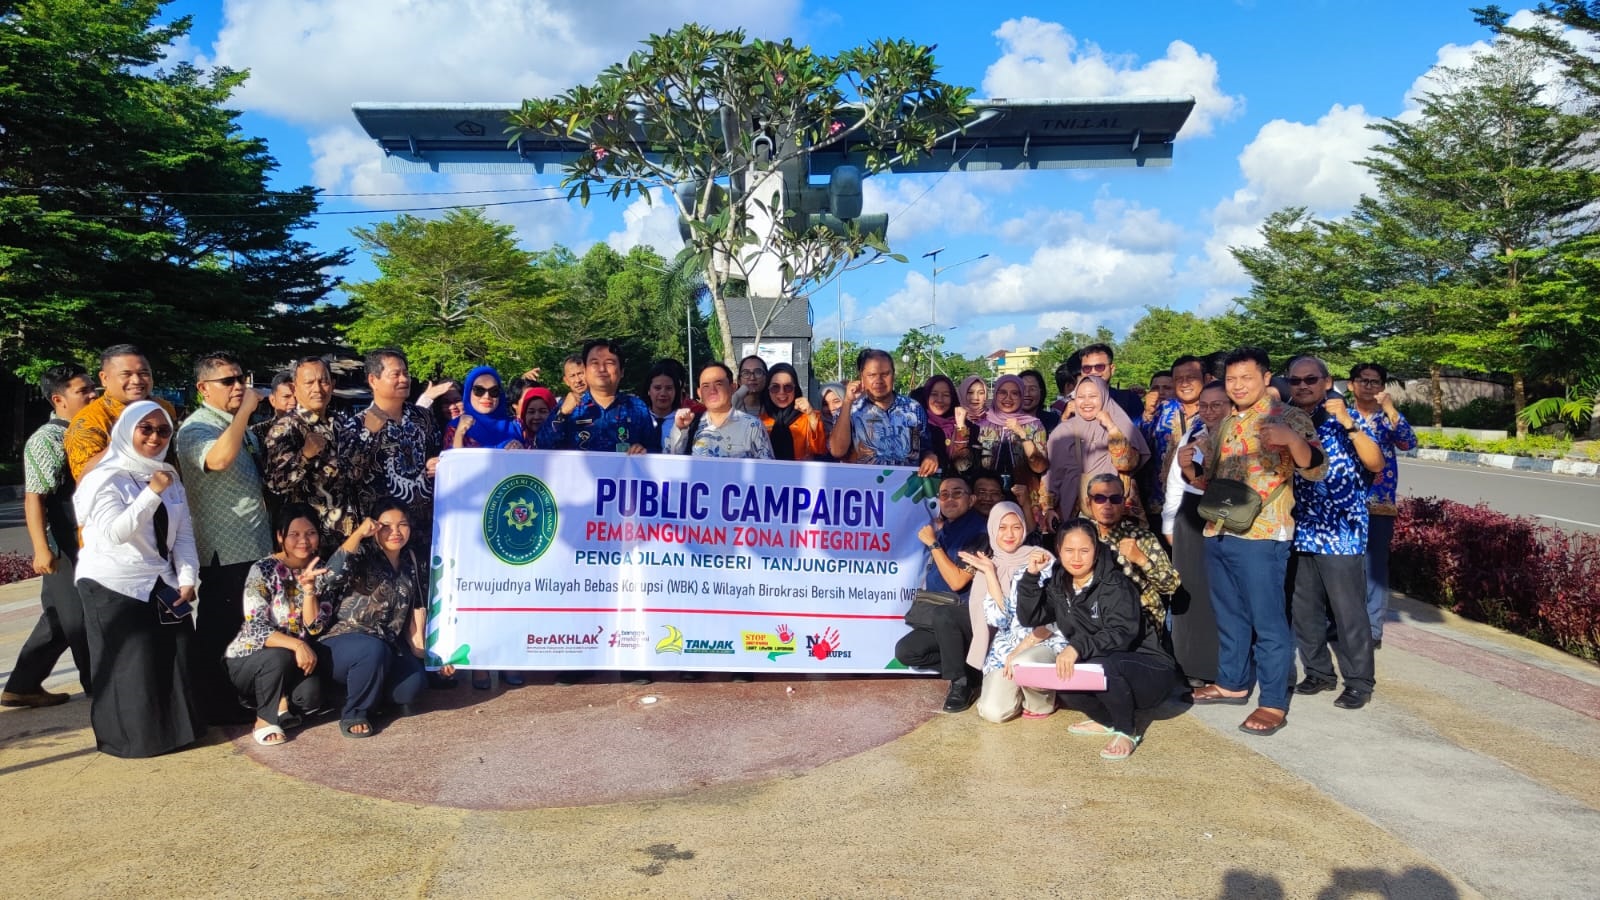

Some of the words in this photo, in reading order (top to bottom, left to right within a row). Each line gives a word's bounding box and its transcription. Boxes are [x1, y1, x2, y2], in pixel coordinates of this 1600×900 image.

[596, 478, 710, 521] PUBLIC
[721, 484, 885, 528] CAMPAIGN
[586, 521, 727, 545] PEMBANGUNAN
[733, 527, 784, 548] ZONA
[789, 529, 891, 553] INTEGRITAS
[575, 551, 685, 567] PENGADILAN
[691, 554, 752, 570] NEGERI
[761, 557, 899, 575] TANJUNGPINANG
[456, 578, 531, 595] Terwujudnya
[535, 578, 580, 595] Wilayah
[584, 579, 618, 593] Bebas
[667, 579, 698, 596] (WBK)
[701, 581, 710, 594] &
[713, 581, 755, 599] Wilayah
[758, 583, 808, 598] Birokrasi
[811, 585, 845, 600] Bersih
[849, 586, 897, 603] Melayani
[527, 634, 600, 645] BerAKHLAK
[685, 639, 734, 649] TANJAK
[808, 650, 852, 658] KRUPSI
